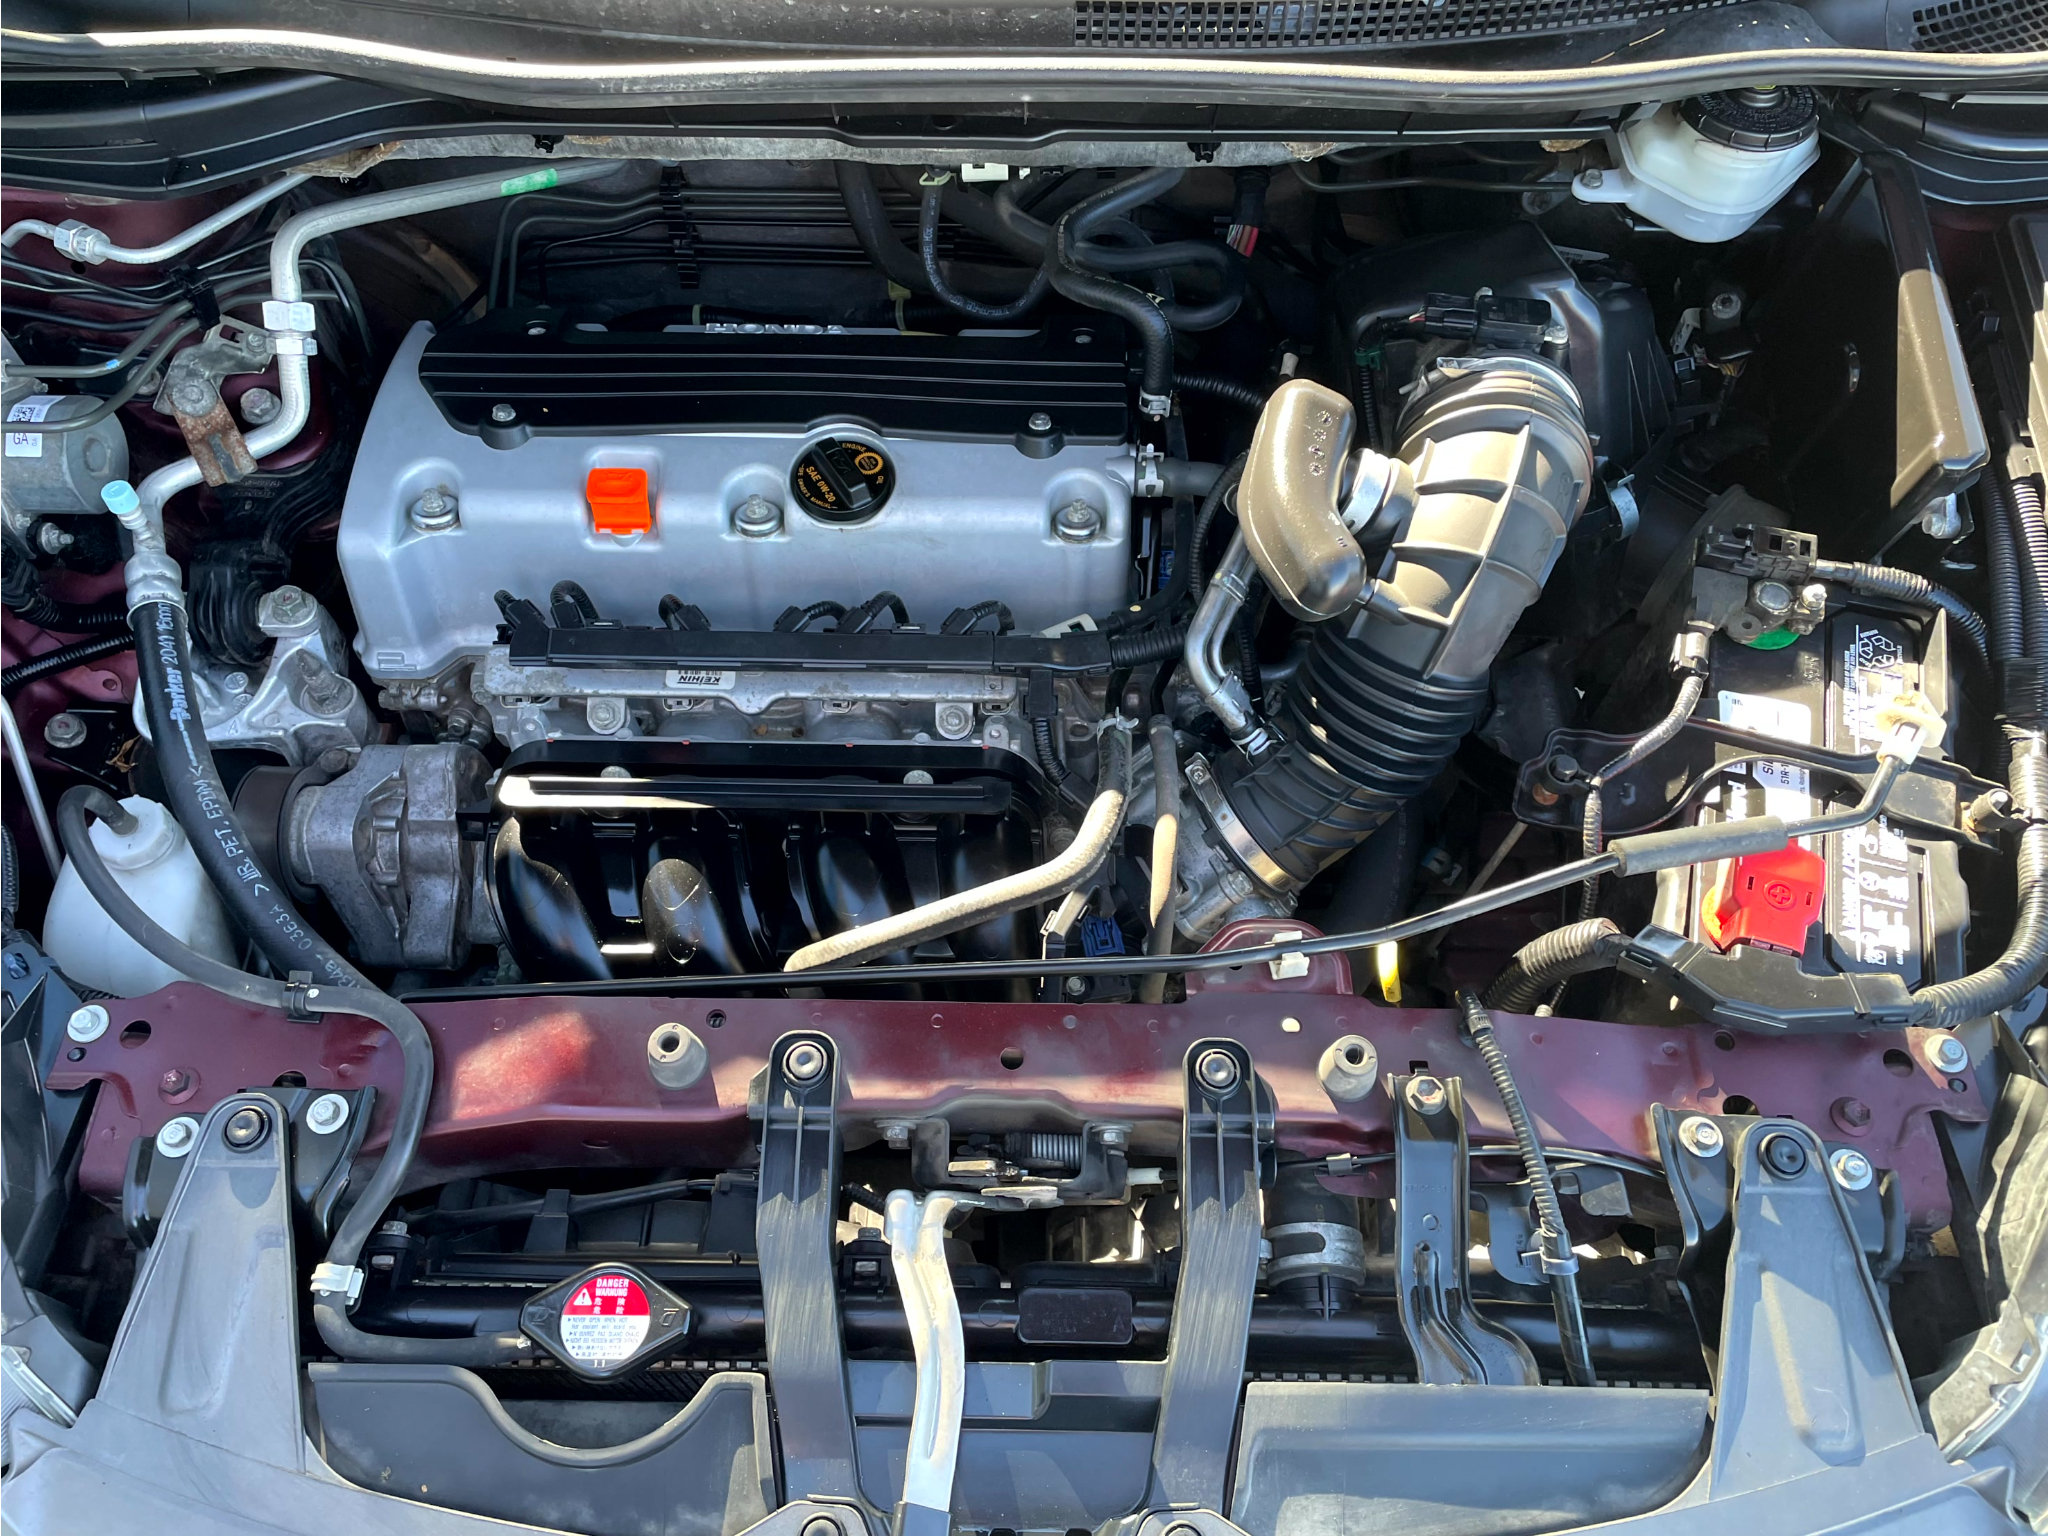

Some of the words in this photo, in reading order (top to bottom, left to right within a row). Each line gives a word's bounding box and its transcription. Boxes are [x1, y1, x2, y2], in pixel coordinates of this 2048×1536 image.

[704, 323, 848, 335] HONDA
[842, 442, 866, 452] ENGINE
[806, 466, 822, 482] SAE
[816, 480, 836, 502] 0W-20
[158, 636, 178, 665] 2041
[678, 675, 721, 684] KEIHIN
[164, 667, 192, 720] Parker
[596, 1278, 630, 1288] DANGER
[595, 1288, 628, 1296] WARNUNG
